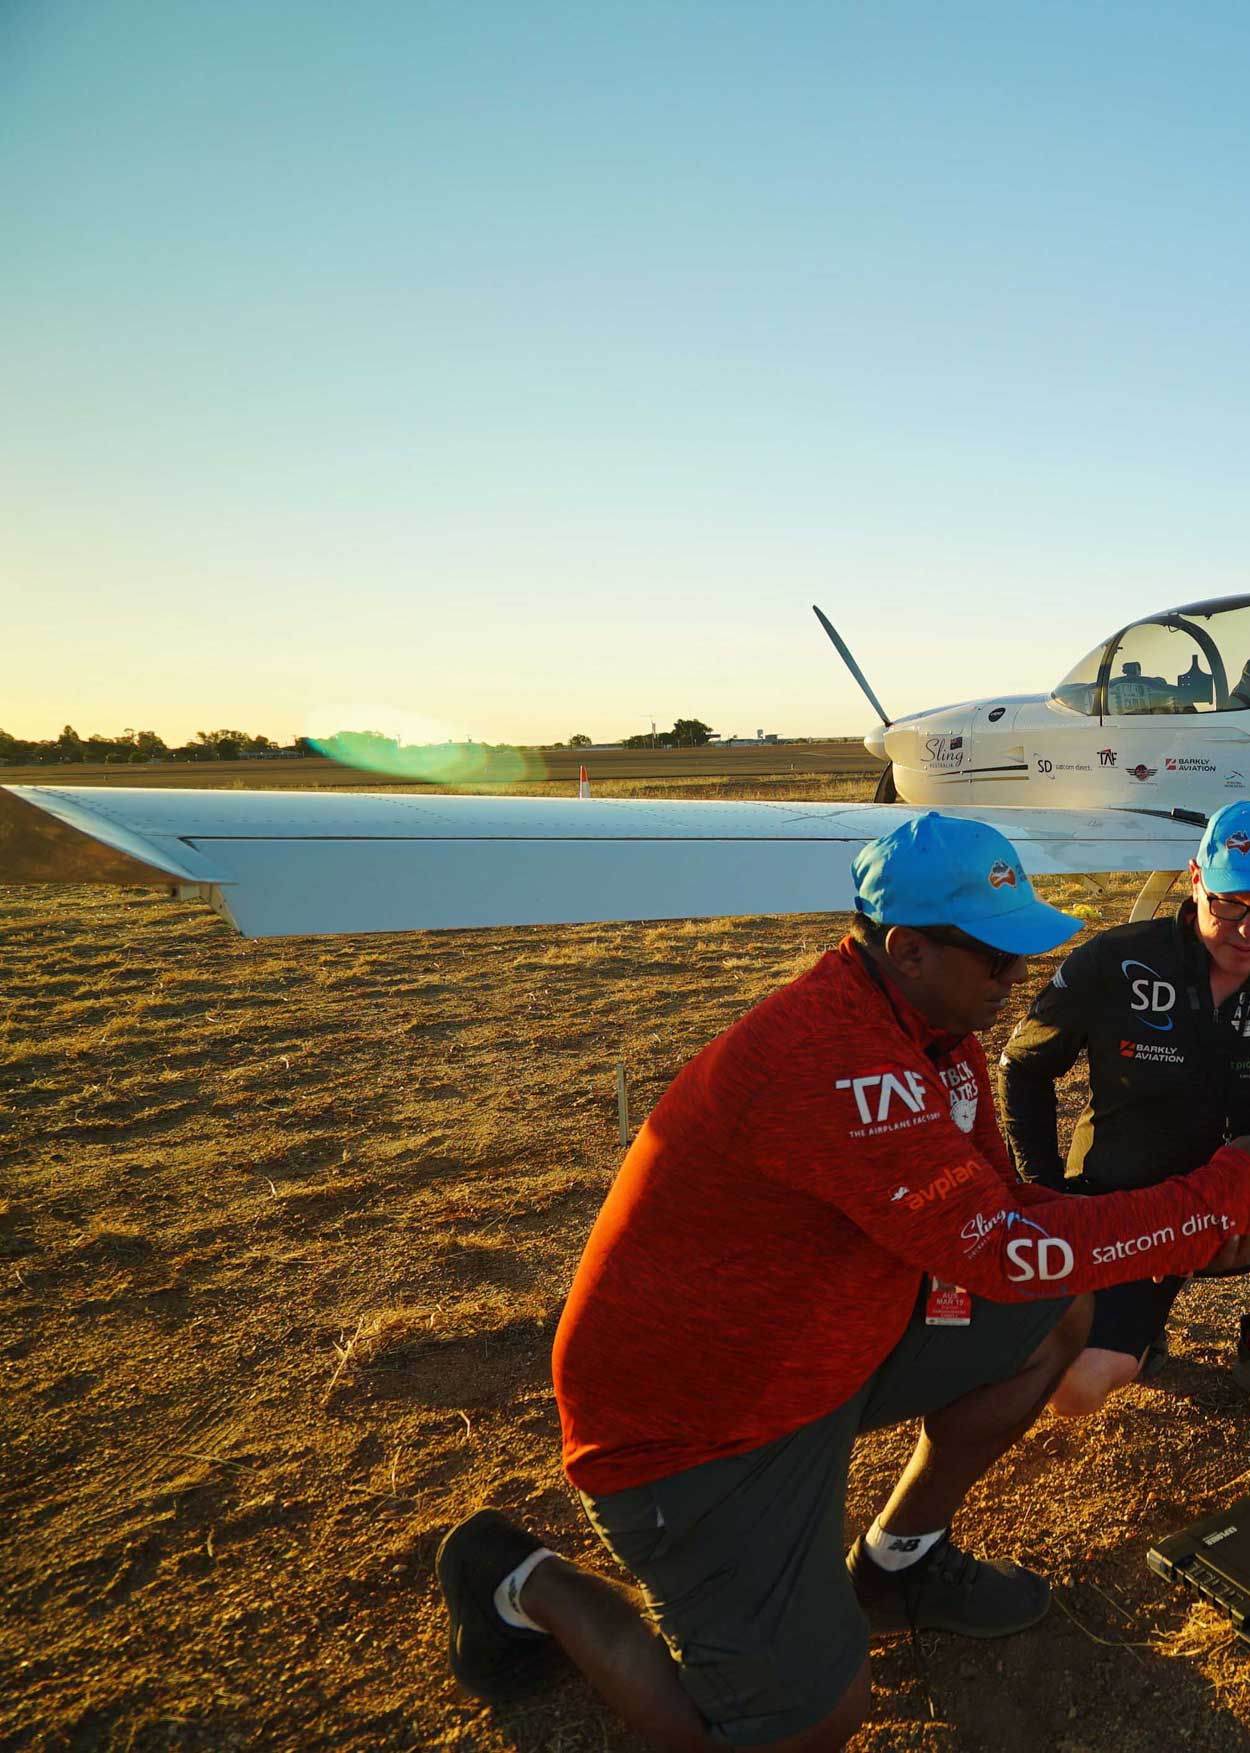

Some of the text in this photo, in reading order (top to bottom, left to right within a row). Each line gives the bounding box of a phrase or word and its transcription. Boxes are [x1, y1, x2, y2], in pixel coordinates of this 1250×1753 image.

[920, 735, 964, 767] Sling
[1037, 759, 1053, 773] SD
[1096, 751, 1118, 766] TAF
[1131, 979, 1176, 1012] SD
[1135, 1052, 1185, 1063] AVIATION
[1136, 1043, 1178, 1055] BARKLY
[835, 1070, 927, 1125] TAF
[849, 1130, 866, 1139] THE
[868, 1119, 912, 1136] AIRPLANE
[908, 1160, 982, 1210] avplan
[960, 1209, 1007, 1254] Sling
[1092, 1227, 1176, 1265] satcom
[1006, 1237, 1075, 1282] SD
